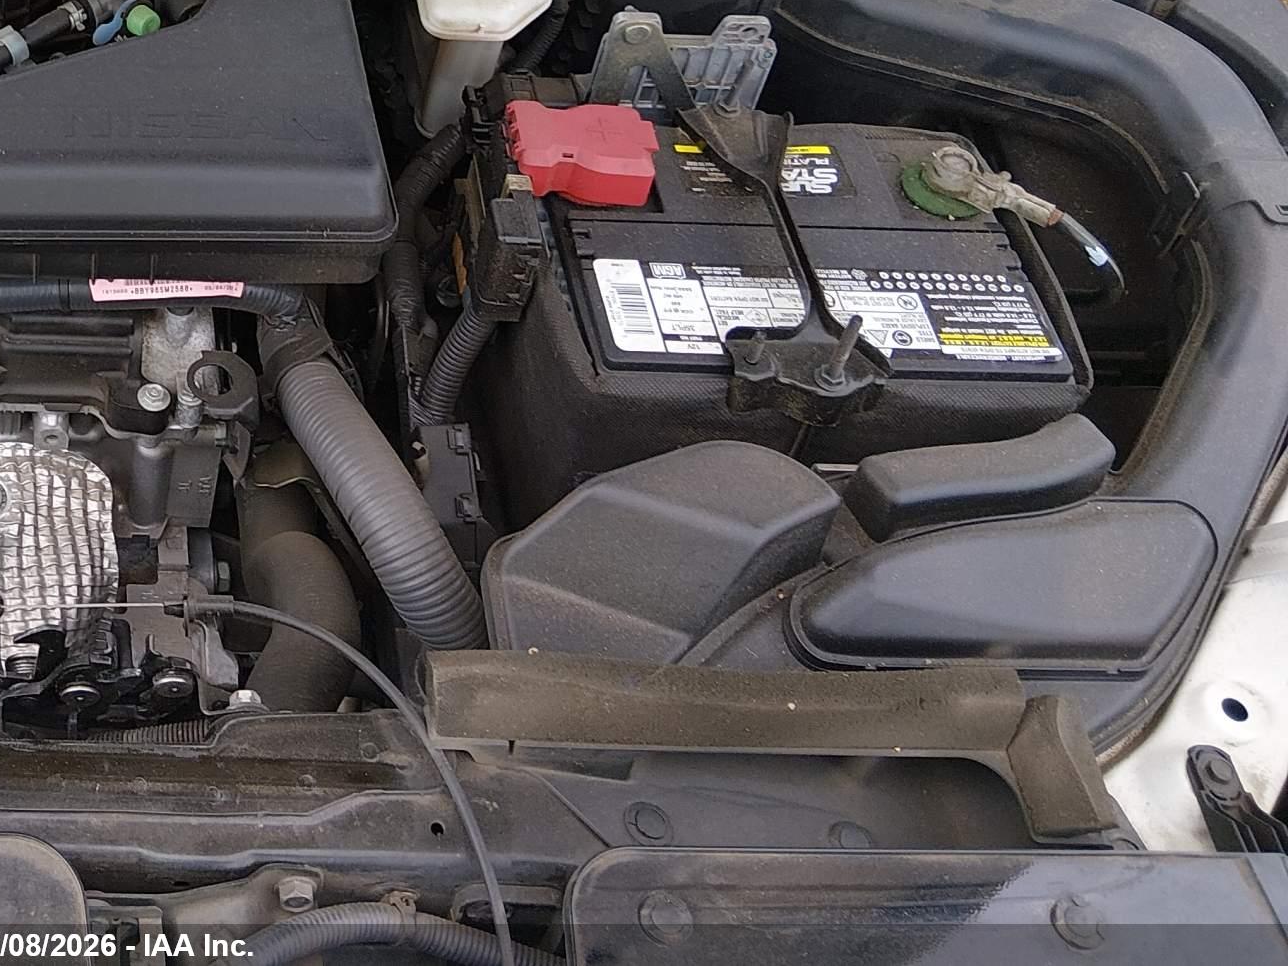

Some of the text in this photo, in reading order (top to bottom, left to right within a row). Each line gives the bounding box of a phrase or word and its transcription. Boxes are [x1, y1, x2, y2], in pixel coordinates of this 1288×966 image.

[64, 112, 330, 142] NISSAN
[783, 157, 829, 165] PLATI
[781, 168, 838, 183] STA
[781, 180, 832, 193] SUP
[653, 265, 682, 275] AGM
